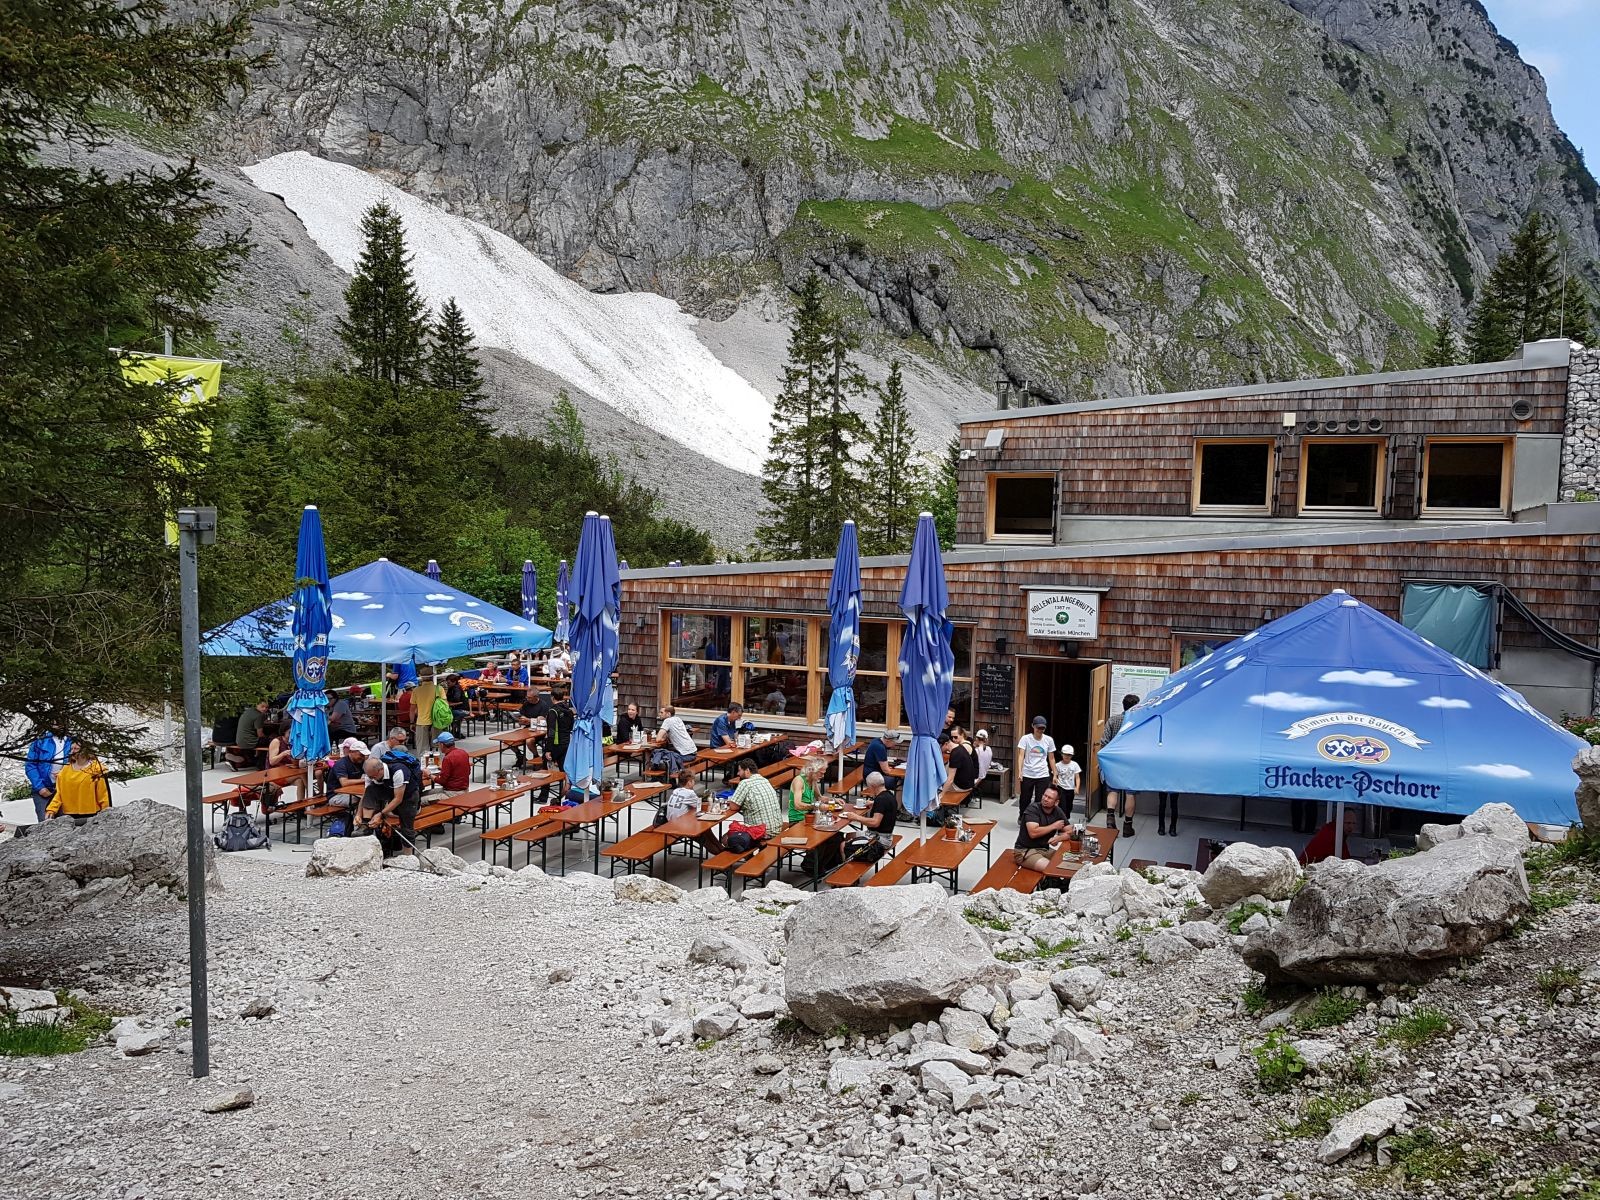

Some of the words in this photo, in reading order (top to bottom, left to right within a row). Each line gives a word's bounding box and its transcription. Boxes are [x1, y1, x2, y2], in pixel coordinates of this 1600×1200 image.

[467, 635, 513, 651] Hacker-Pschorr
[1367, 717, 1407, 738] Bayern
[1264, 765, 1441, 799] Hacker-Pschorr
